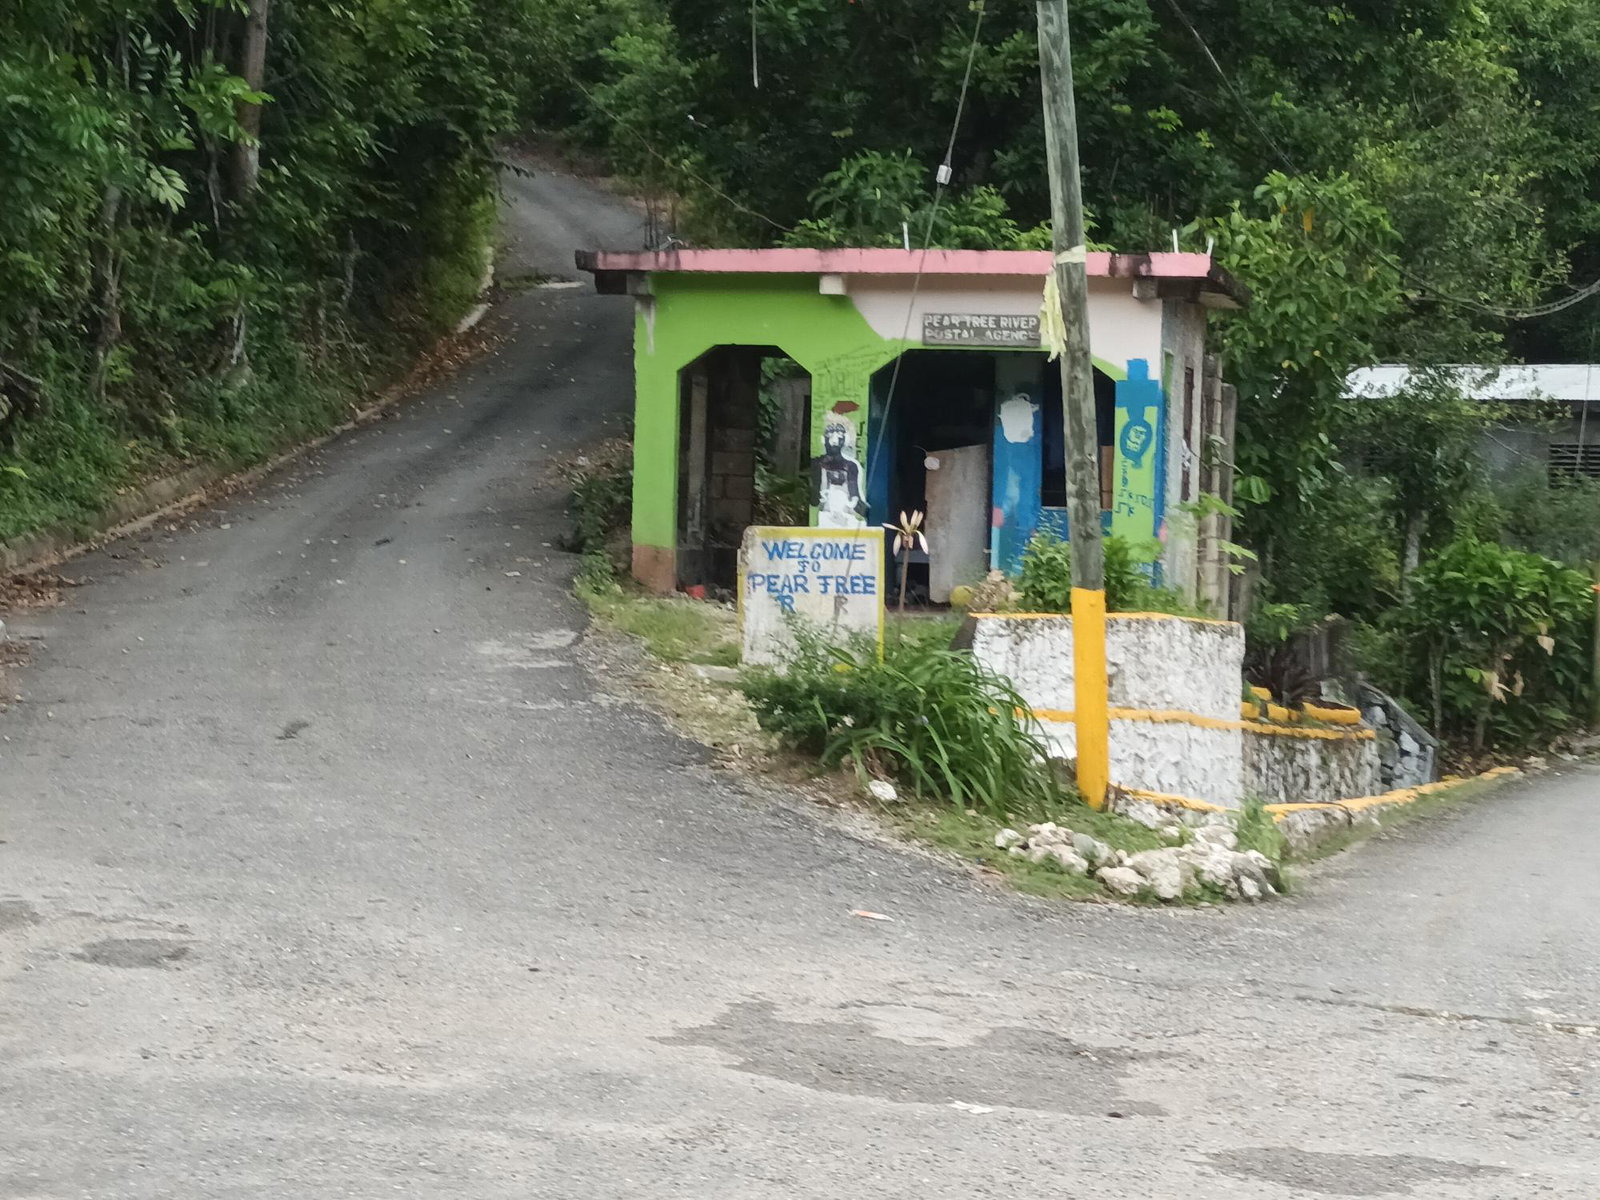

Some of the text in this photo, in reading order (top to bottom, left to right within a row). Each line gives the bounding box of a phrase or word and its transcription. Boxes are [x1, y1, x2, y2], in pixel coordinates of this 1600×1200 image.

[924, 315, 959, 327] PEAR
[966, 316, 997, 328] TREE
[985, 330, 1039, 341] AGENC
[762, 541, 867, 560] WELCOME
[749, 574, 876, 595] PEAR TREE
